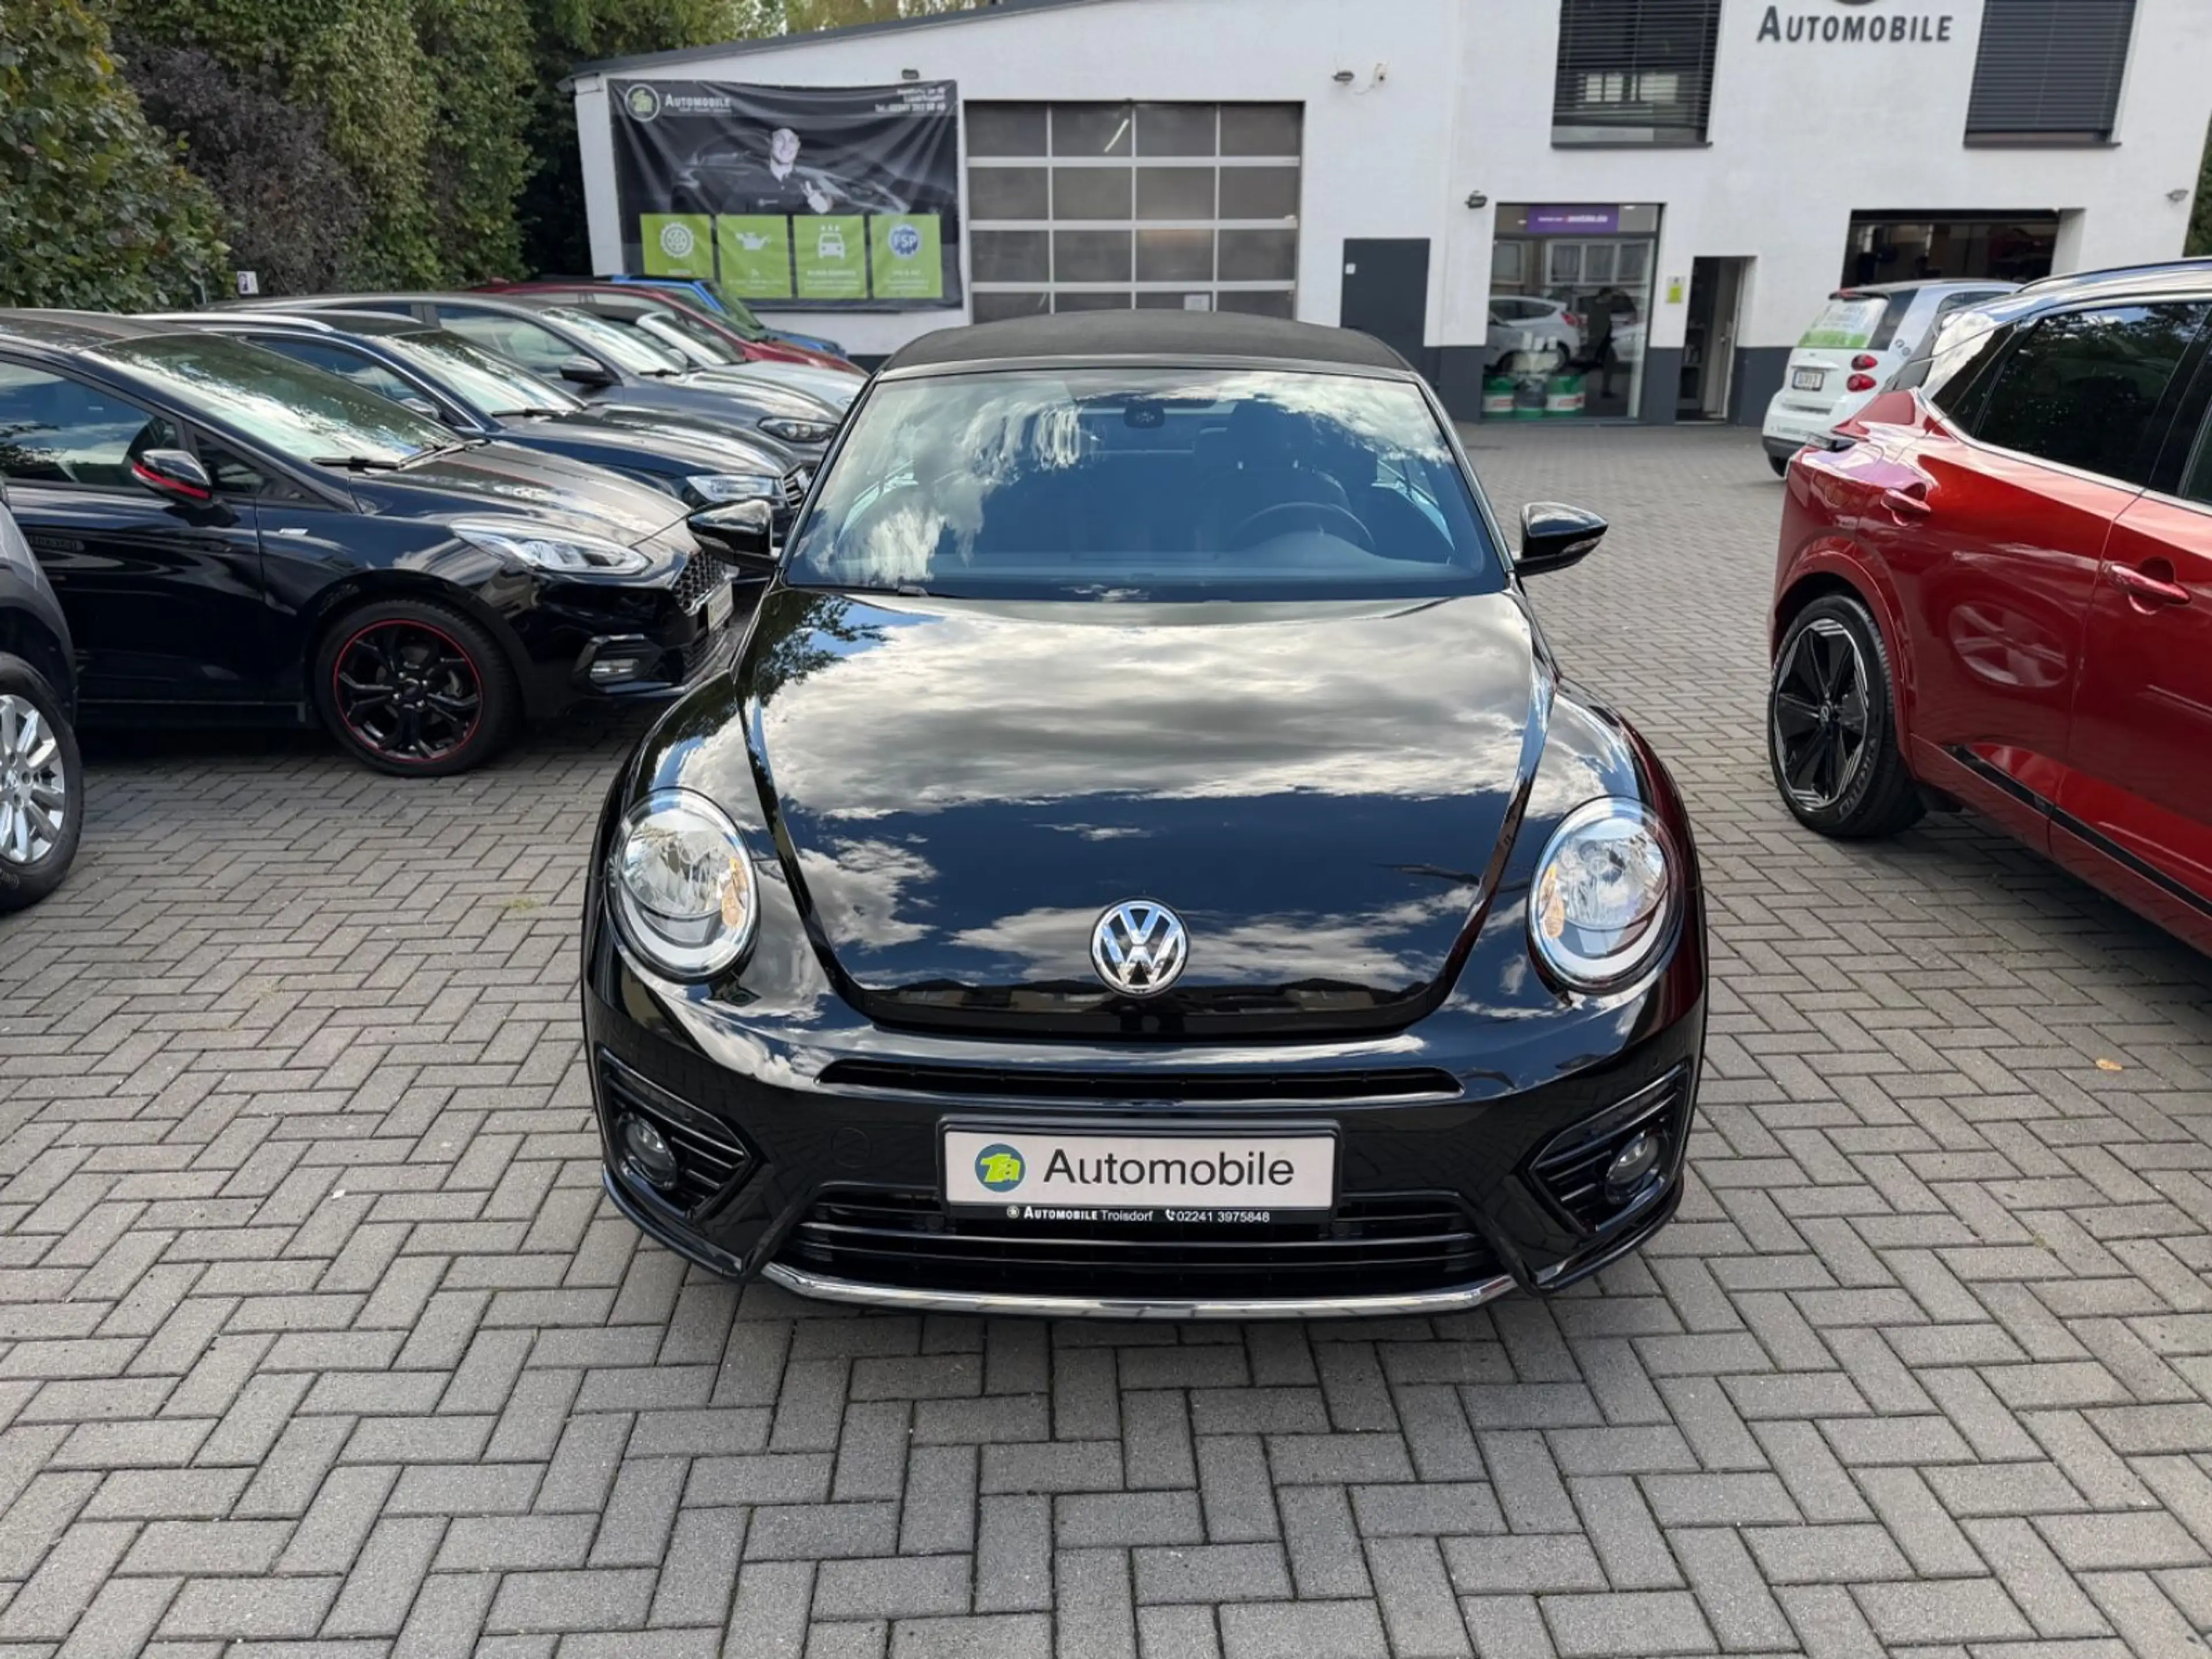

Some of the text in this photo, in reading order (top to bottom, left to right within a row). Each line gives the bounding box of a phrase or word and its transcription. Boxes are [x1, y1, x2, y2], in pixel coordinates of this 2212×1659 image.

[1756, 5, 1953, 43] AUTOMOBILE
[1043, 1149, 1294, 1186] Automobile
[1024, 1206, 1097, 1220] AUTOMOBILE
[1100, 1209, 1154, 1222] Troisdorf
